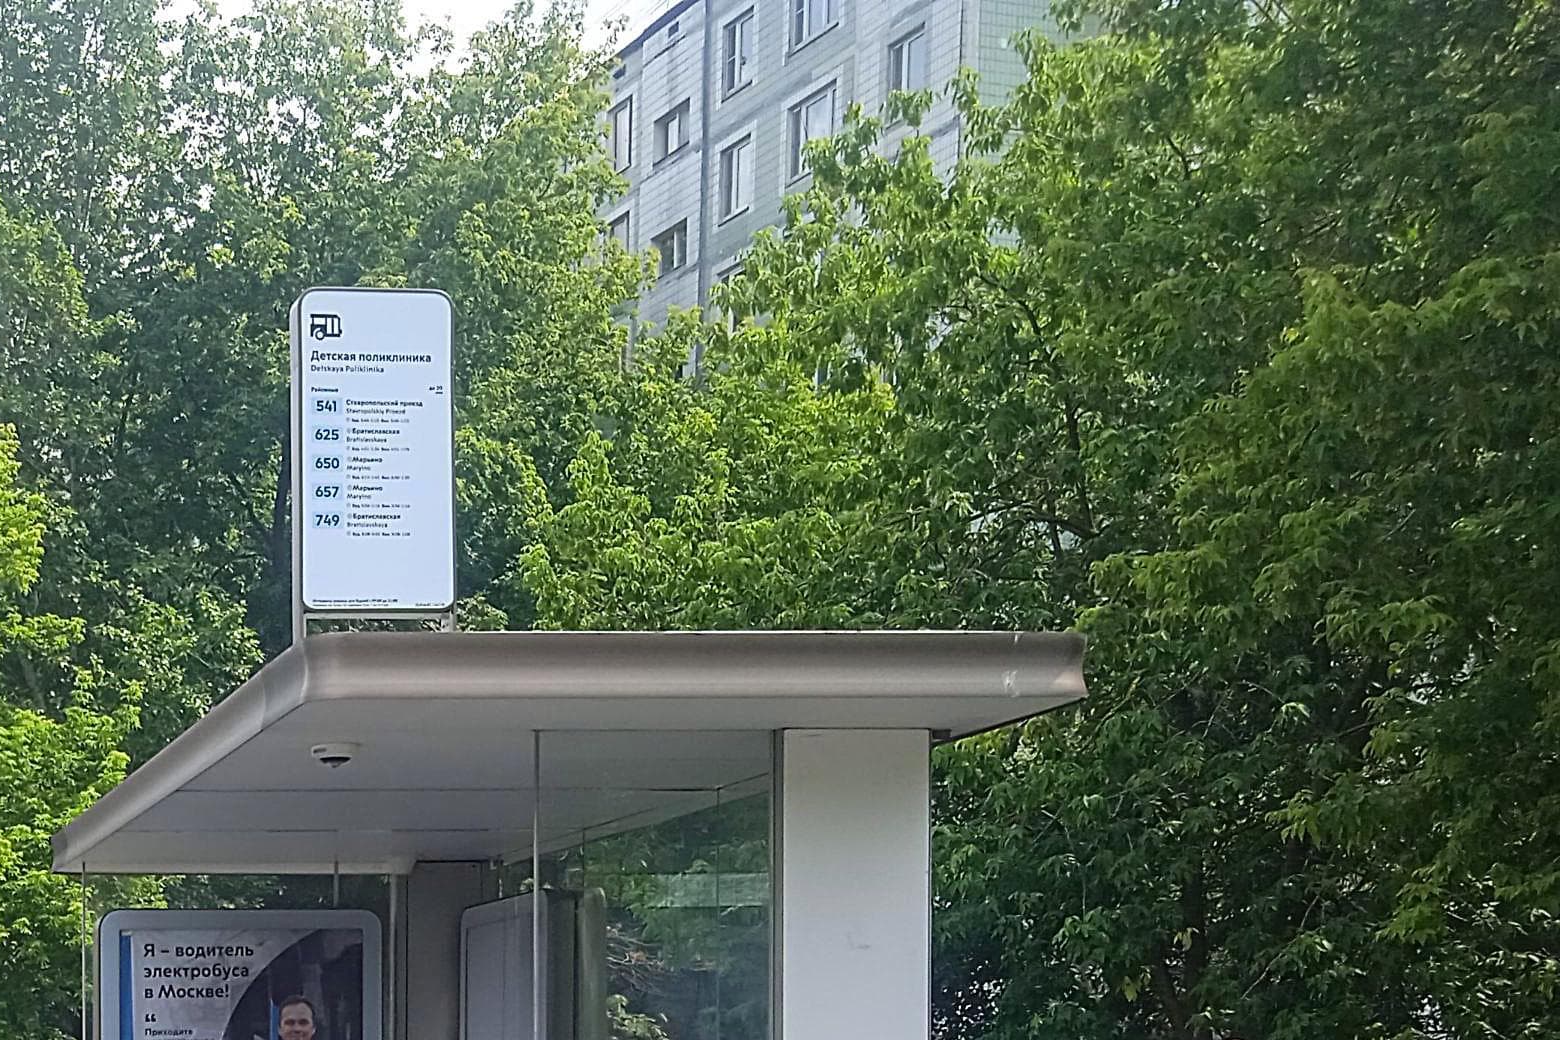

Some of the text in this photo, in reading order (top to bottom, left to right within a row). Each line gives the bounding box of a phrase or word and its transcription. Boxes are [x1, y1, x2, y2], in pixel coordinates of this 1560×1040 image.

[310, 350, 432, 363] Детская поликлиника
[316, 400, 337, 412] 541
[315, 428, 340, 441] 625
[315, 457, 340, 469] 650
[315, 486, 340, 498] 657
[315, 514, 340, 527] 749
[352, 513, 401, 521] Братиславская
[143, 943, 155, 957] Я
[175, 945, 254, 959] водитель
[143, 963, 249, 980] электробуса
[144, 984, 230, 999] в Москве!
[144, 1028, 193, 1037] Приходите
